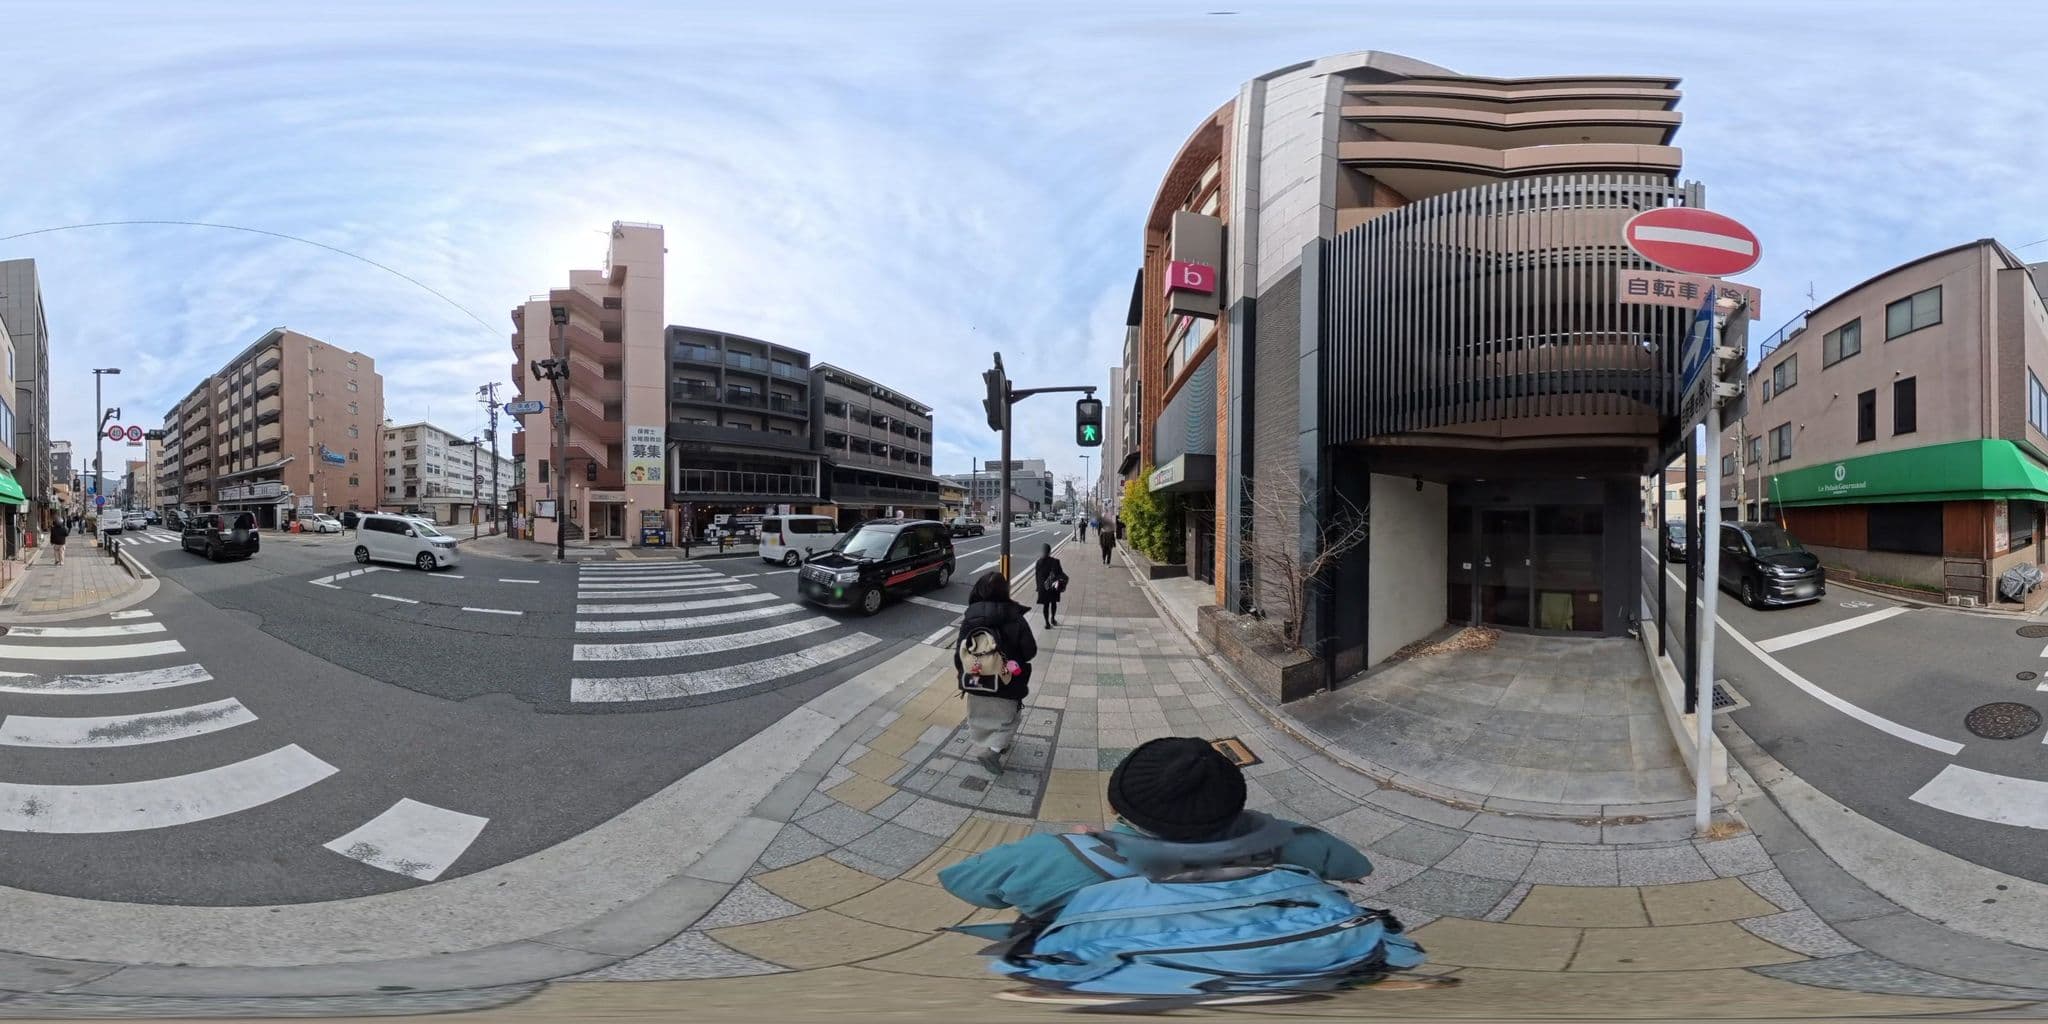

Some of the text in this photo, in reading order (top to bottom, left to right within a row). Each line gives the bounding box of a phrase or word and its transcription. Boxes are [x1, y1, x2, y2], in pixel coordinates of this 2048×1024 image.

[1184, 267, 1201, 286] b
[1628, 278, 1757, 313] 自転車除く
[632, 445, 662, 458] 募集
